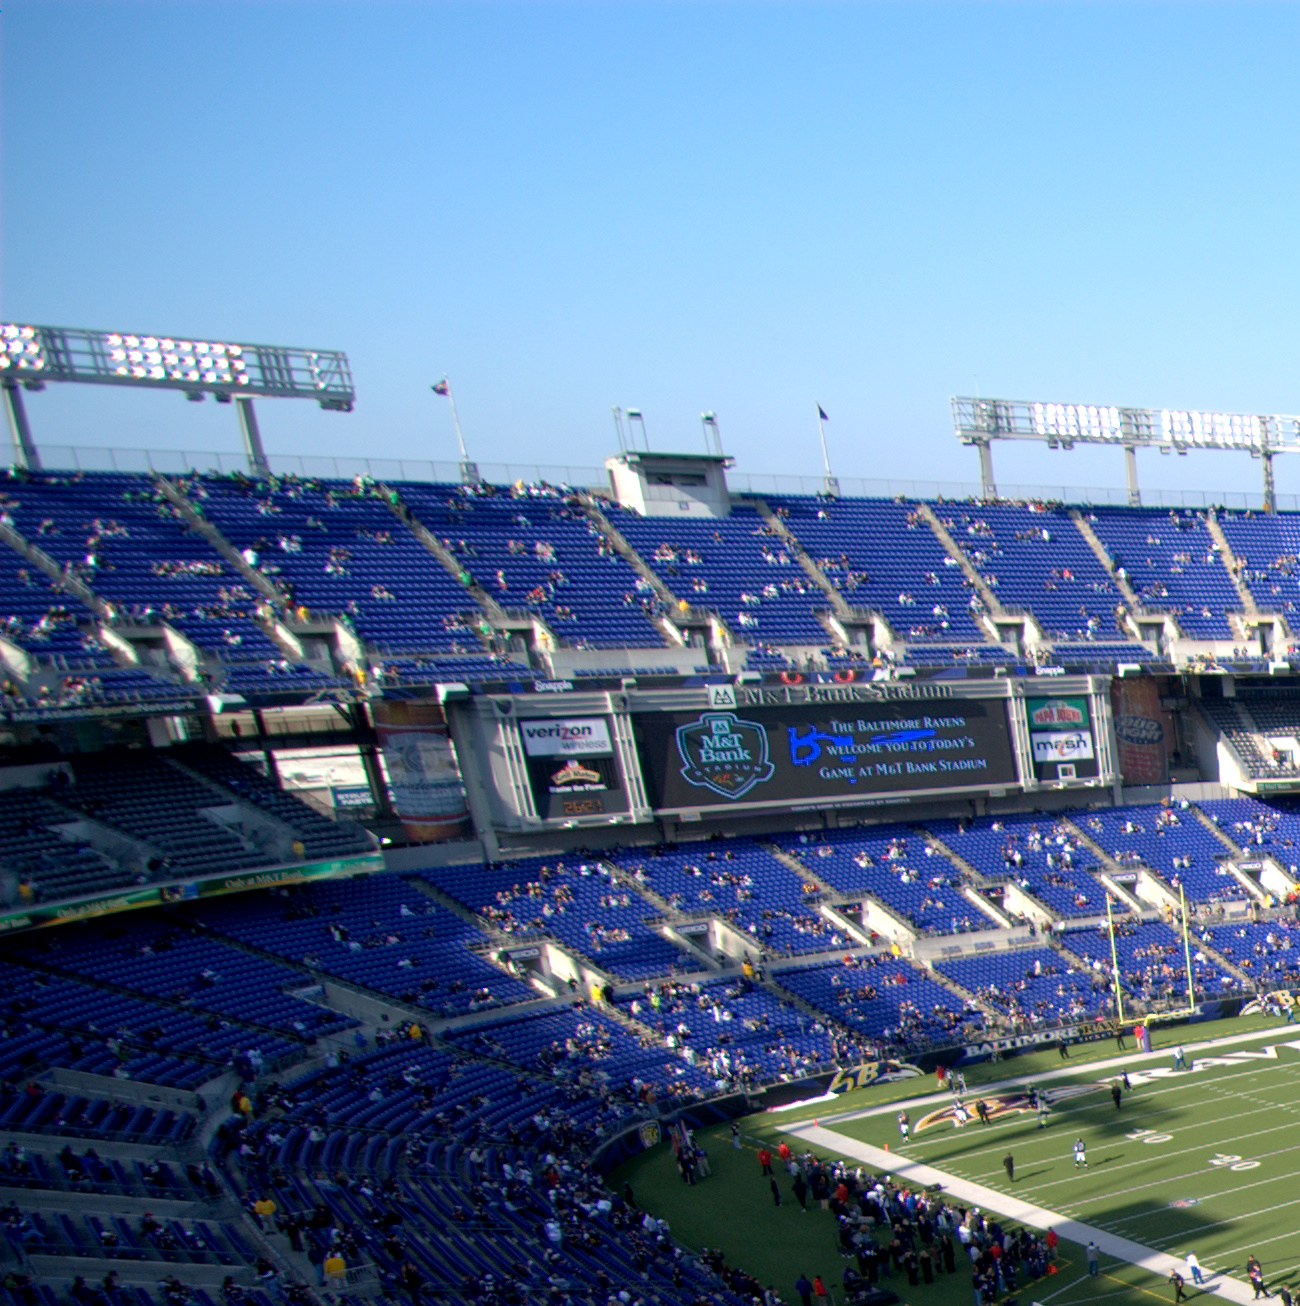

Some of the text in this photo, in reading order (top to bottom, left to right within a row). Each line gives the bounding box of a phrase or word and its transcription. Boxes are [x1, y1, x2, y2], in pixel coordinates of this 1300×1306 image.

[744, 682, 953, 705] M&T Bank Stadium
[525, 724, 593, 740] verizon
[830, 716, 966, 734] THE BALTIMORE RAVENS
[561, 738, 608, 750] wireless
[701, 733, 744, 748] M&T
[827, 737, 975, 757] WELCOME YOU TO TODAY'S
[699, 747, 752, 763] Bank
[819, 758, 988, 780] GAME AT M&T BANK STADIUM
[965, 1026, 1080, 1057] BALTIMORE
[1125, 1128, 1174, 1144] 10
[1208, 1153, 1262, 1172] 20
